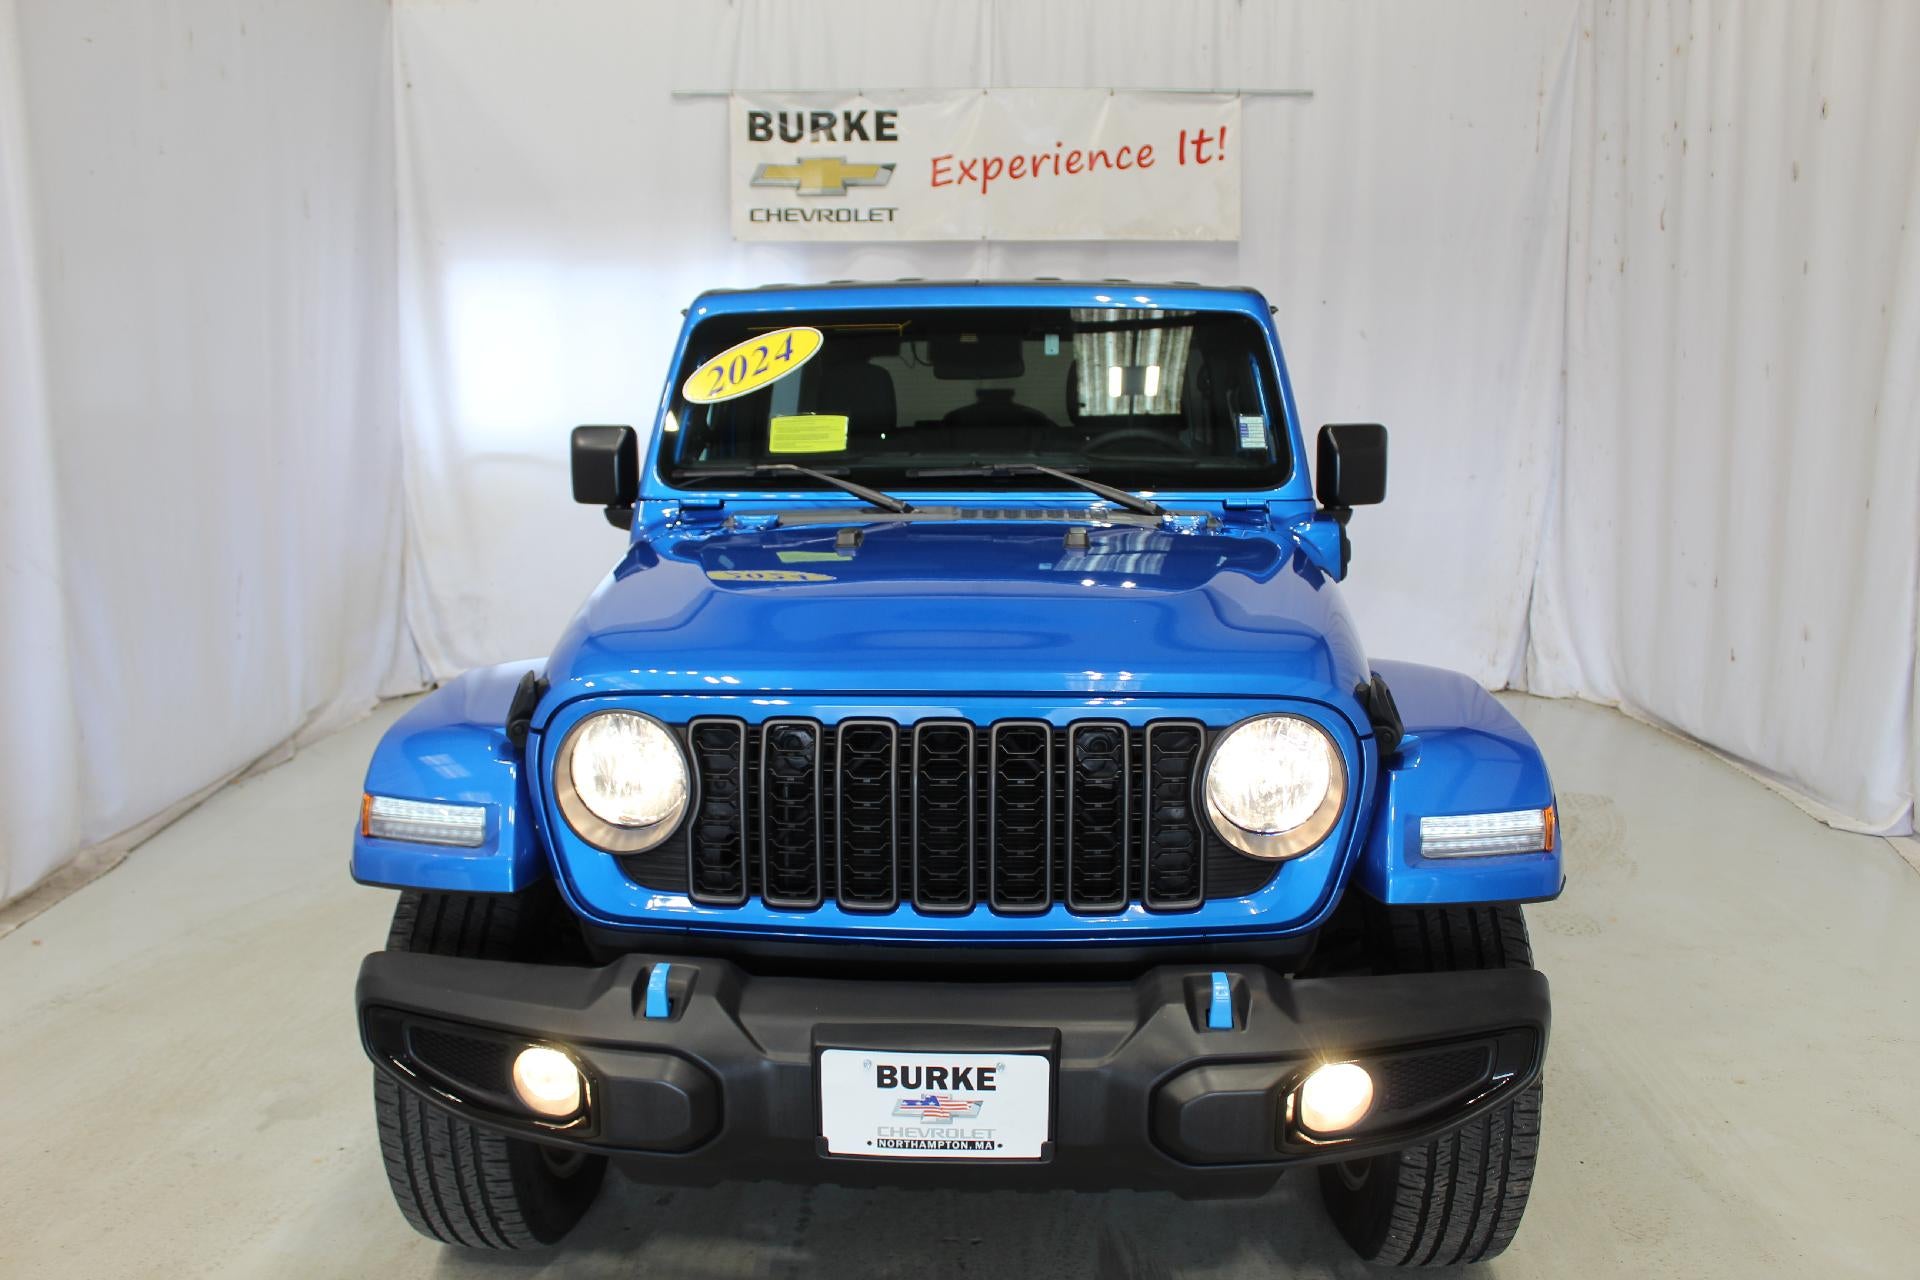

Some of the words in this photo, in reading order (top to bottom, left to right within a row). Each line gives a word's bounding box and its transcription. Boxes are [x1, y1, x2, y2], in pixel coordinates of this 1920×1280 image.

[747, 109, 899, 144] BURKE
[930, 141, 1156, 195] Experience
[1177, 125, 1228, 166] It!
[749, 207, 899, 223] CHEVROLET
[706, 332, 795, 396] 2024
[876, 1064, 997, 1091] BURKE
[877, 1126, 997, 1140] CHEVROLET
[974, 1141, 994, 1150] MA
